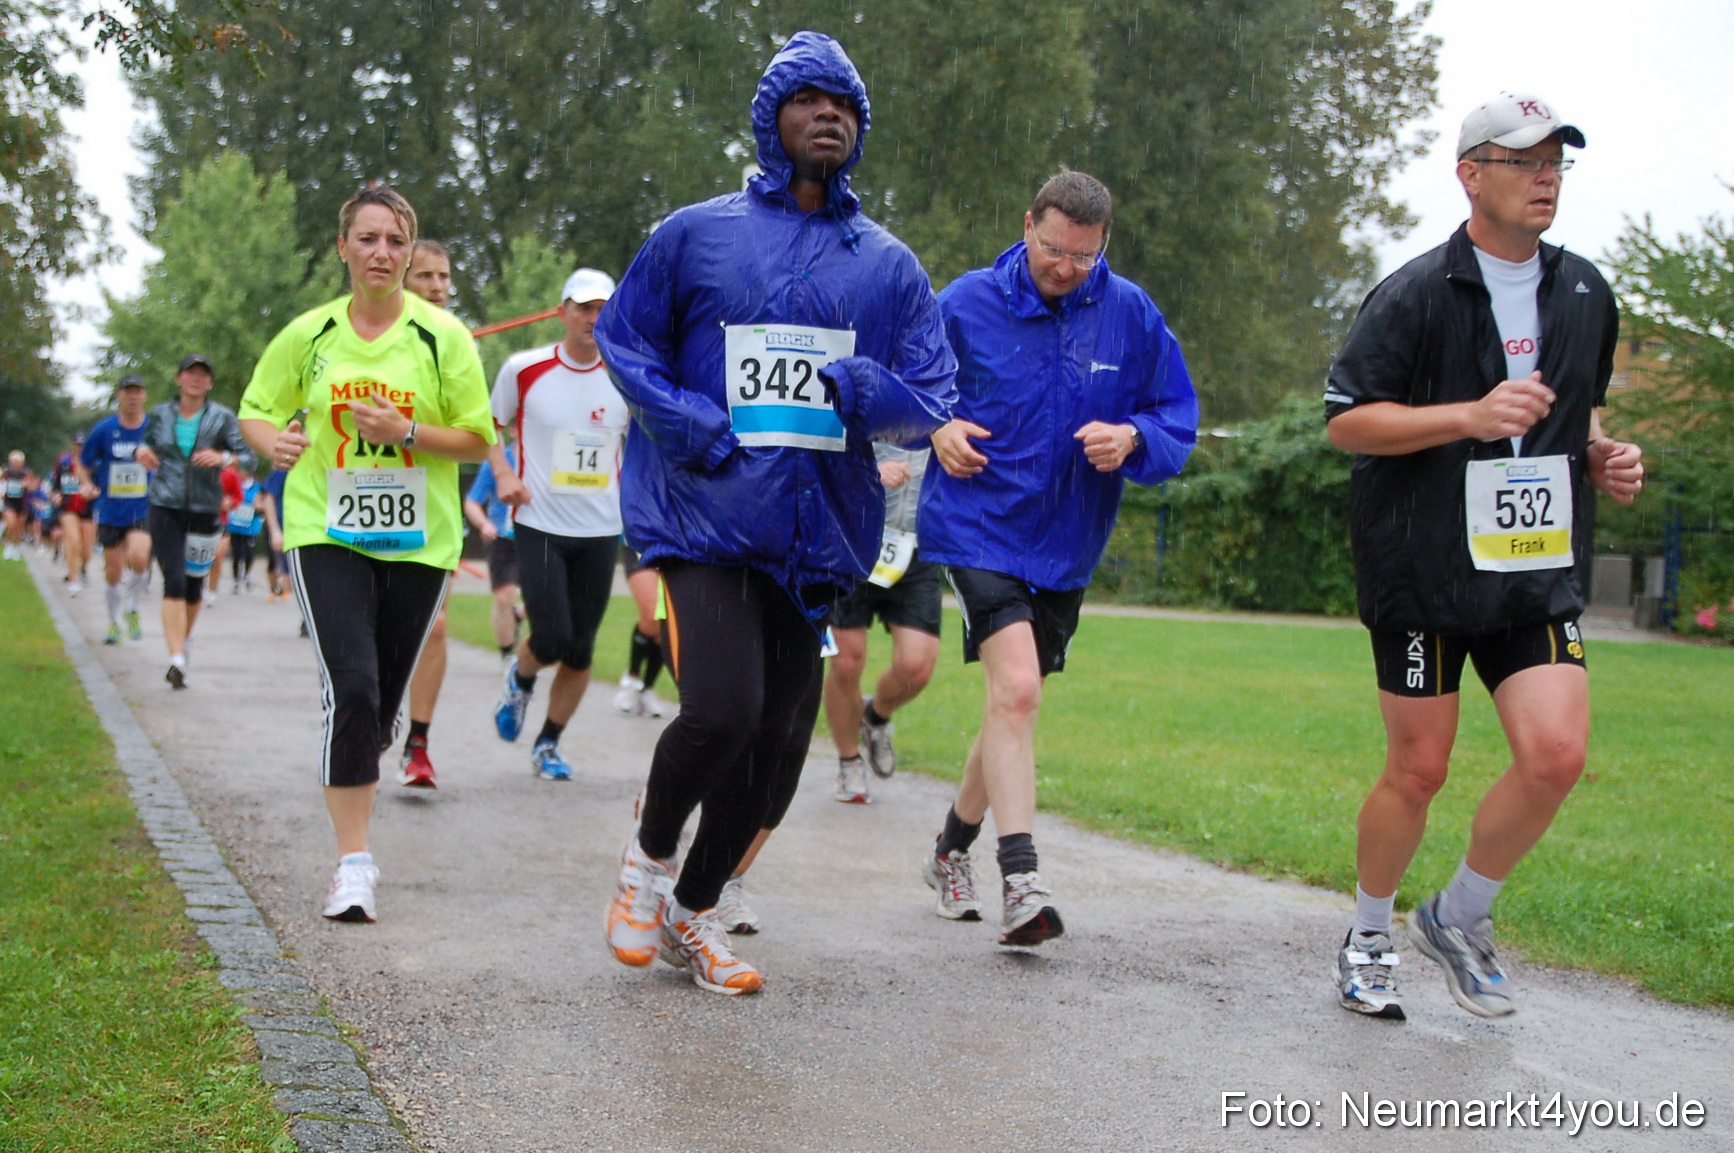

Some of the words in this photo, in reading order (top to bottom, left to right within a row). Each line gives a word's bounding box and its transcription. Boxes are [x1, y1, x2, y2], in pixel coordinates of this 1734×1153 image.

[766, 332, 815, 347] BOCK
[1505, 338, 1534, 356] GO
[330, 381, 416, 404] Müller
[574, 449, 598, 472] 14
[337, 493, 416, 528] 2598
[1495, 487, 1554, 529] 532
[352, 536, 401, 549] Monika
[1510, 537, 1546, 555] Frank
